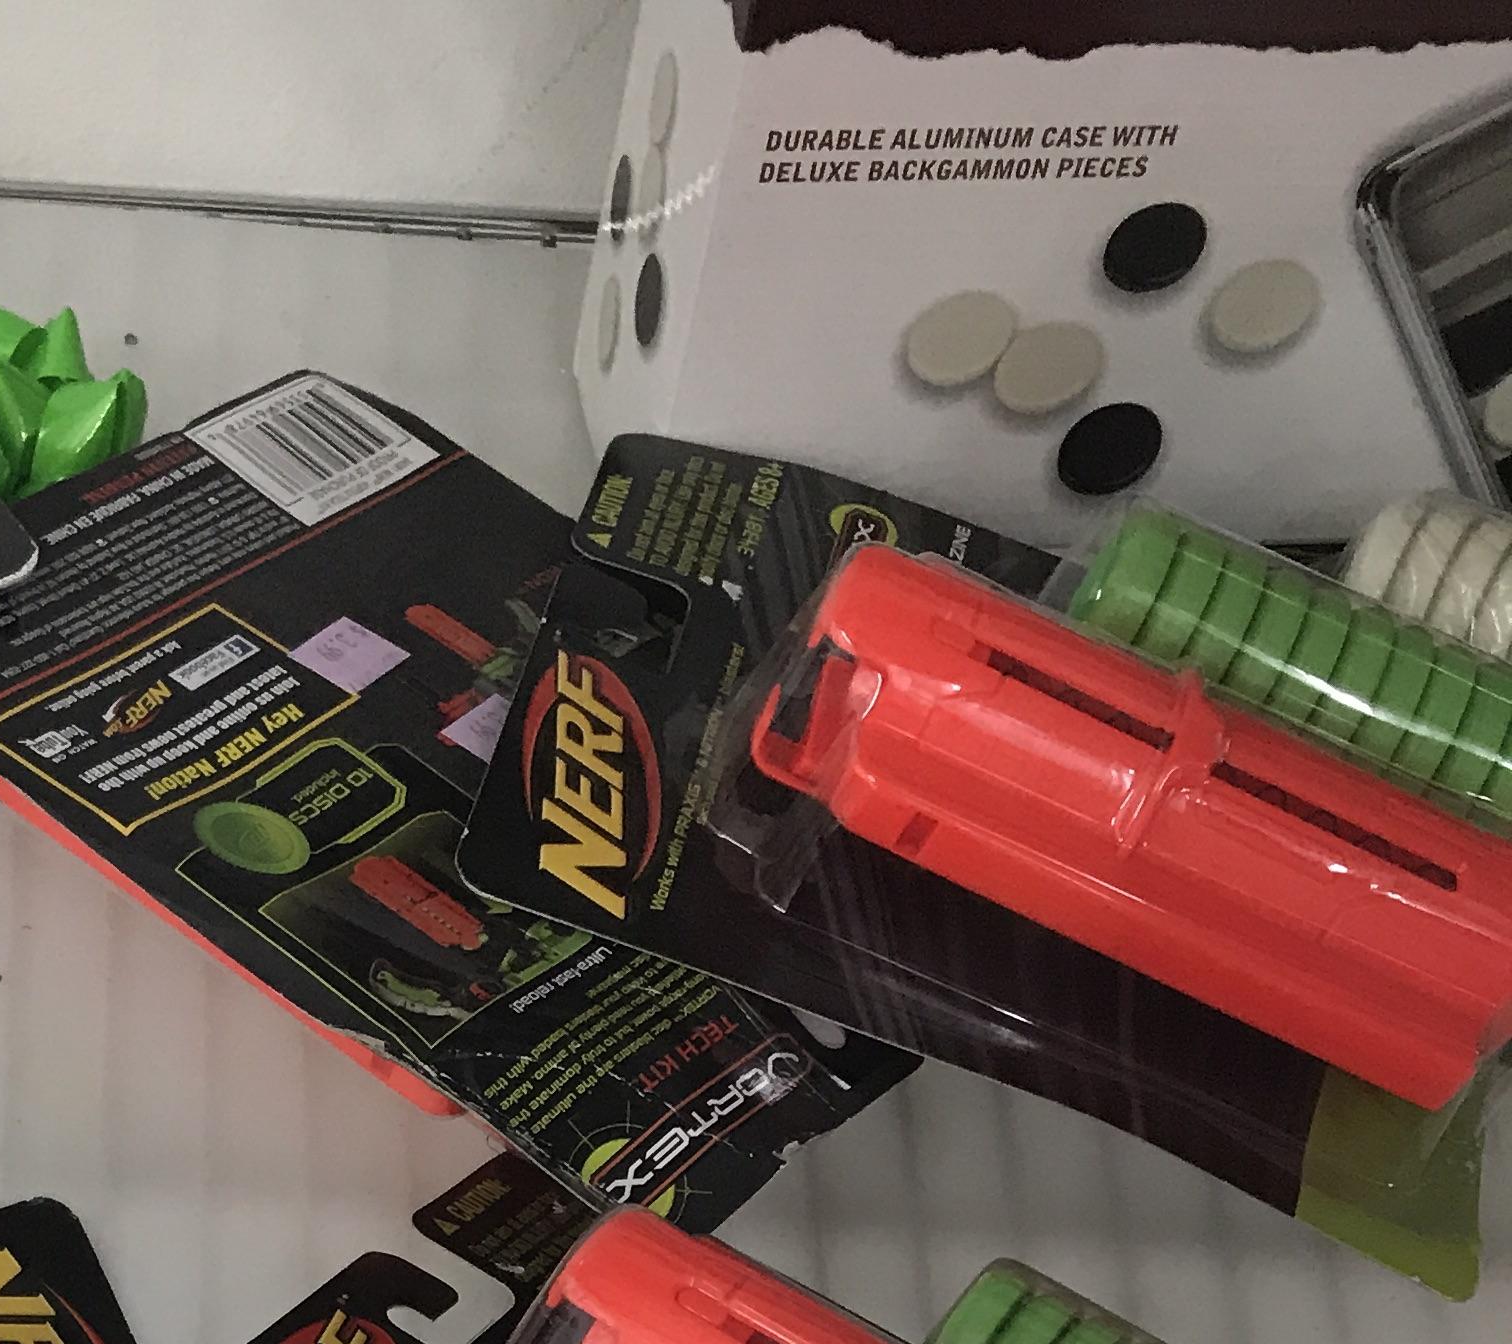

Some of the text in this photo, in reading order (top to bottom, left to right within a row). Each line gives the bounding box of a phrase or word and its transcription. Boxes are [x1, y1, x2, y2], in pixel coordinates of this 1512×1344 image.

[764, 125, 1178, 151] DURABLE ALUMINUM CASE WITH
[759, 156, 1148, 183] DELUXE BACKGAMMON PIECES
[591, 473, 633, 527] CAUTION:
[746, 474, 779, 509] AGES
[736, 514, 764, 556] 34381
[142, 697, 305, 803] Hey NERF Nation!
[286, 764, 373, 828] 10 DISCS
[537, 649, 628, 919] NERF
[650, 837, 685, 912] Works with
[507, 942, 612, 1016] Ultra-fast reload!
[481, 1053, 535, 1099] with this
[633, 1010, 739, 1096] TECH KIT
[496, 1077, 534, 1112] Make
[525, 1061, 584, 1112] dominate
[528, 1091, 579, 1136] ultimate
[603, 1053, 799, 1204] VORTEX
[446, 1169, 513, 1226] CAUTION:
